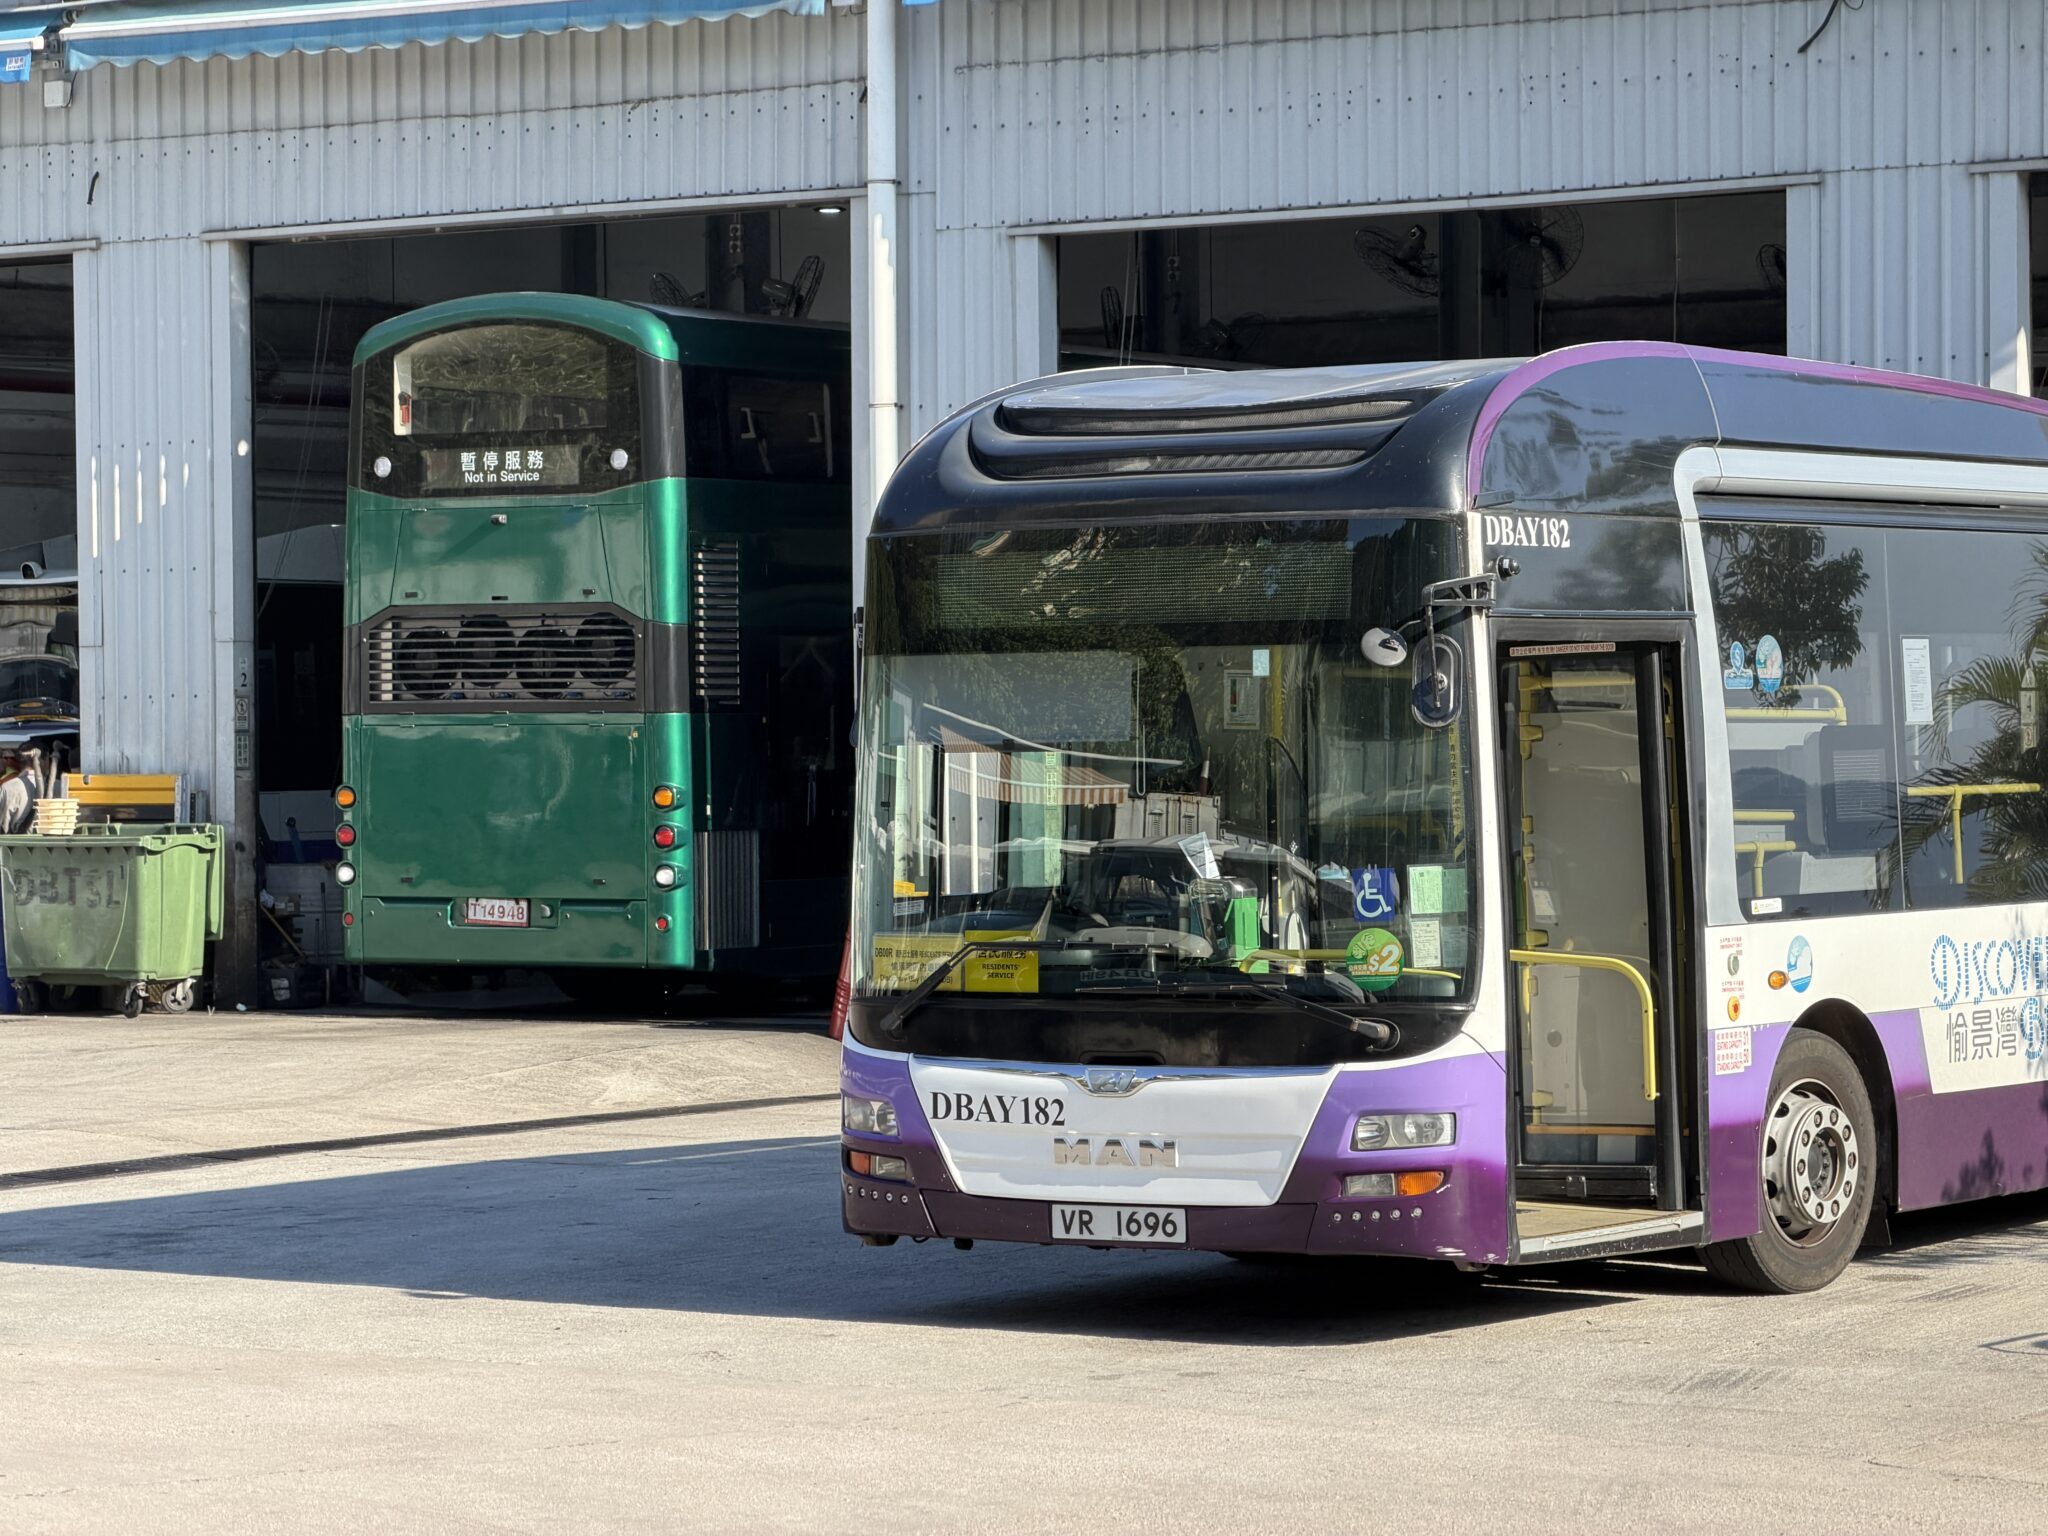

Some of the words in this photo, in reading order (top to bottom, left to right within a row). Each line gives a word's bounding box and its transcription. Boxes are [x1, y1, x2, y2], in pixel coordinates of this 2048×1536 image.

[460, 449, 544, 471] 暫停服務
[464, 471, 484, 483] Not
[487, 470, 497, 482] in
[500, 469, 540, 482] Service
[1483, 515, 1571, 548] DBAY182
[240, 672, 248, 688] 2
[470, 903, 525, 920] T14948
[1368, 944, 1400, 973] $2
[1930, 934, 2048, 1010] DISCOVE
[1946, 1006, 2018, 1063] 愉景灣
[930, 1091, 1066, 1126] DBAY182
[1054, 1136, 1179, 1168] MAN
[1060, 1209, 1095, 1236] VR
[1116, 1210, 1178, 1238] 1696
